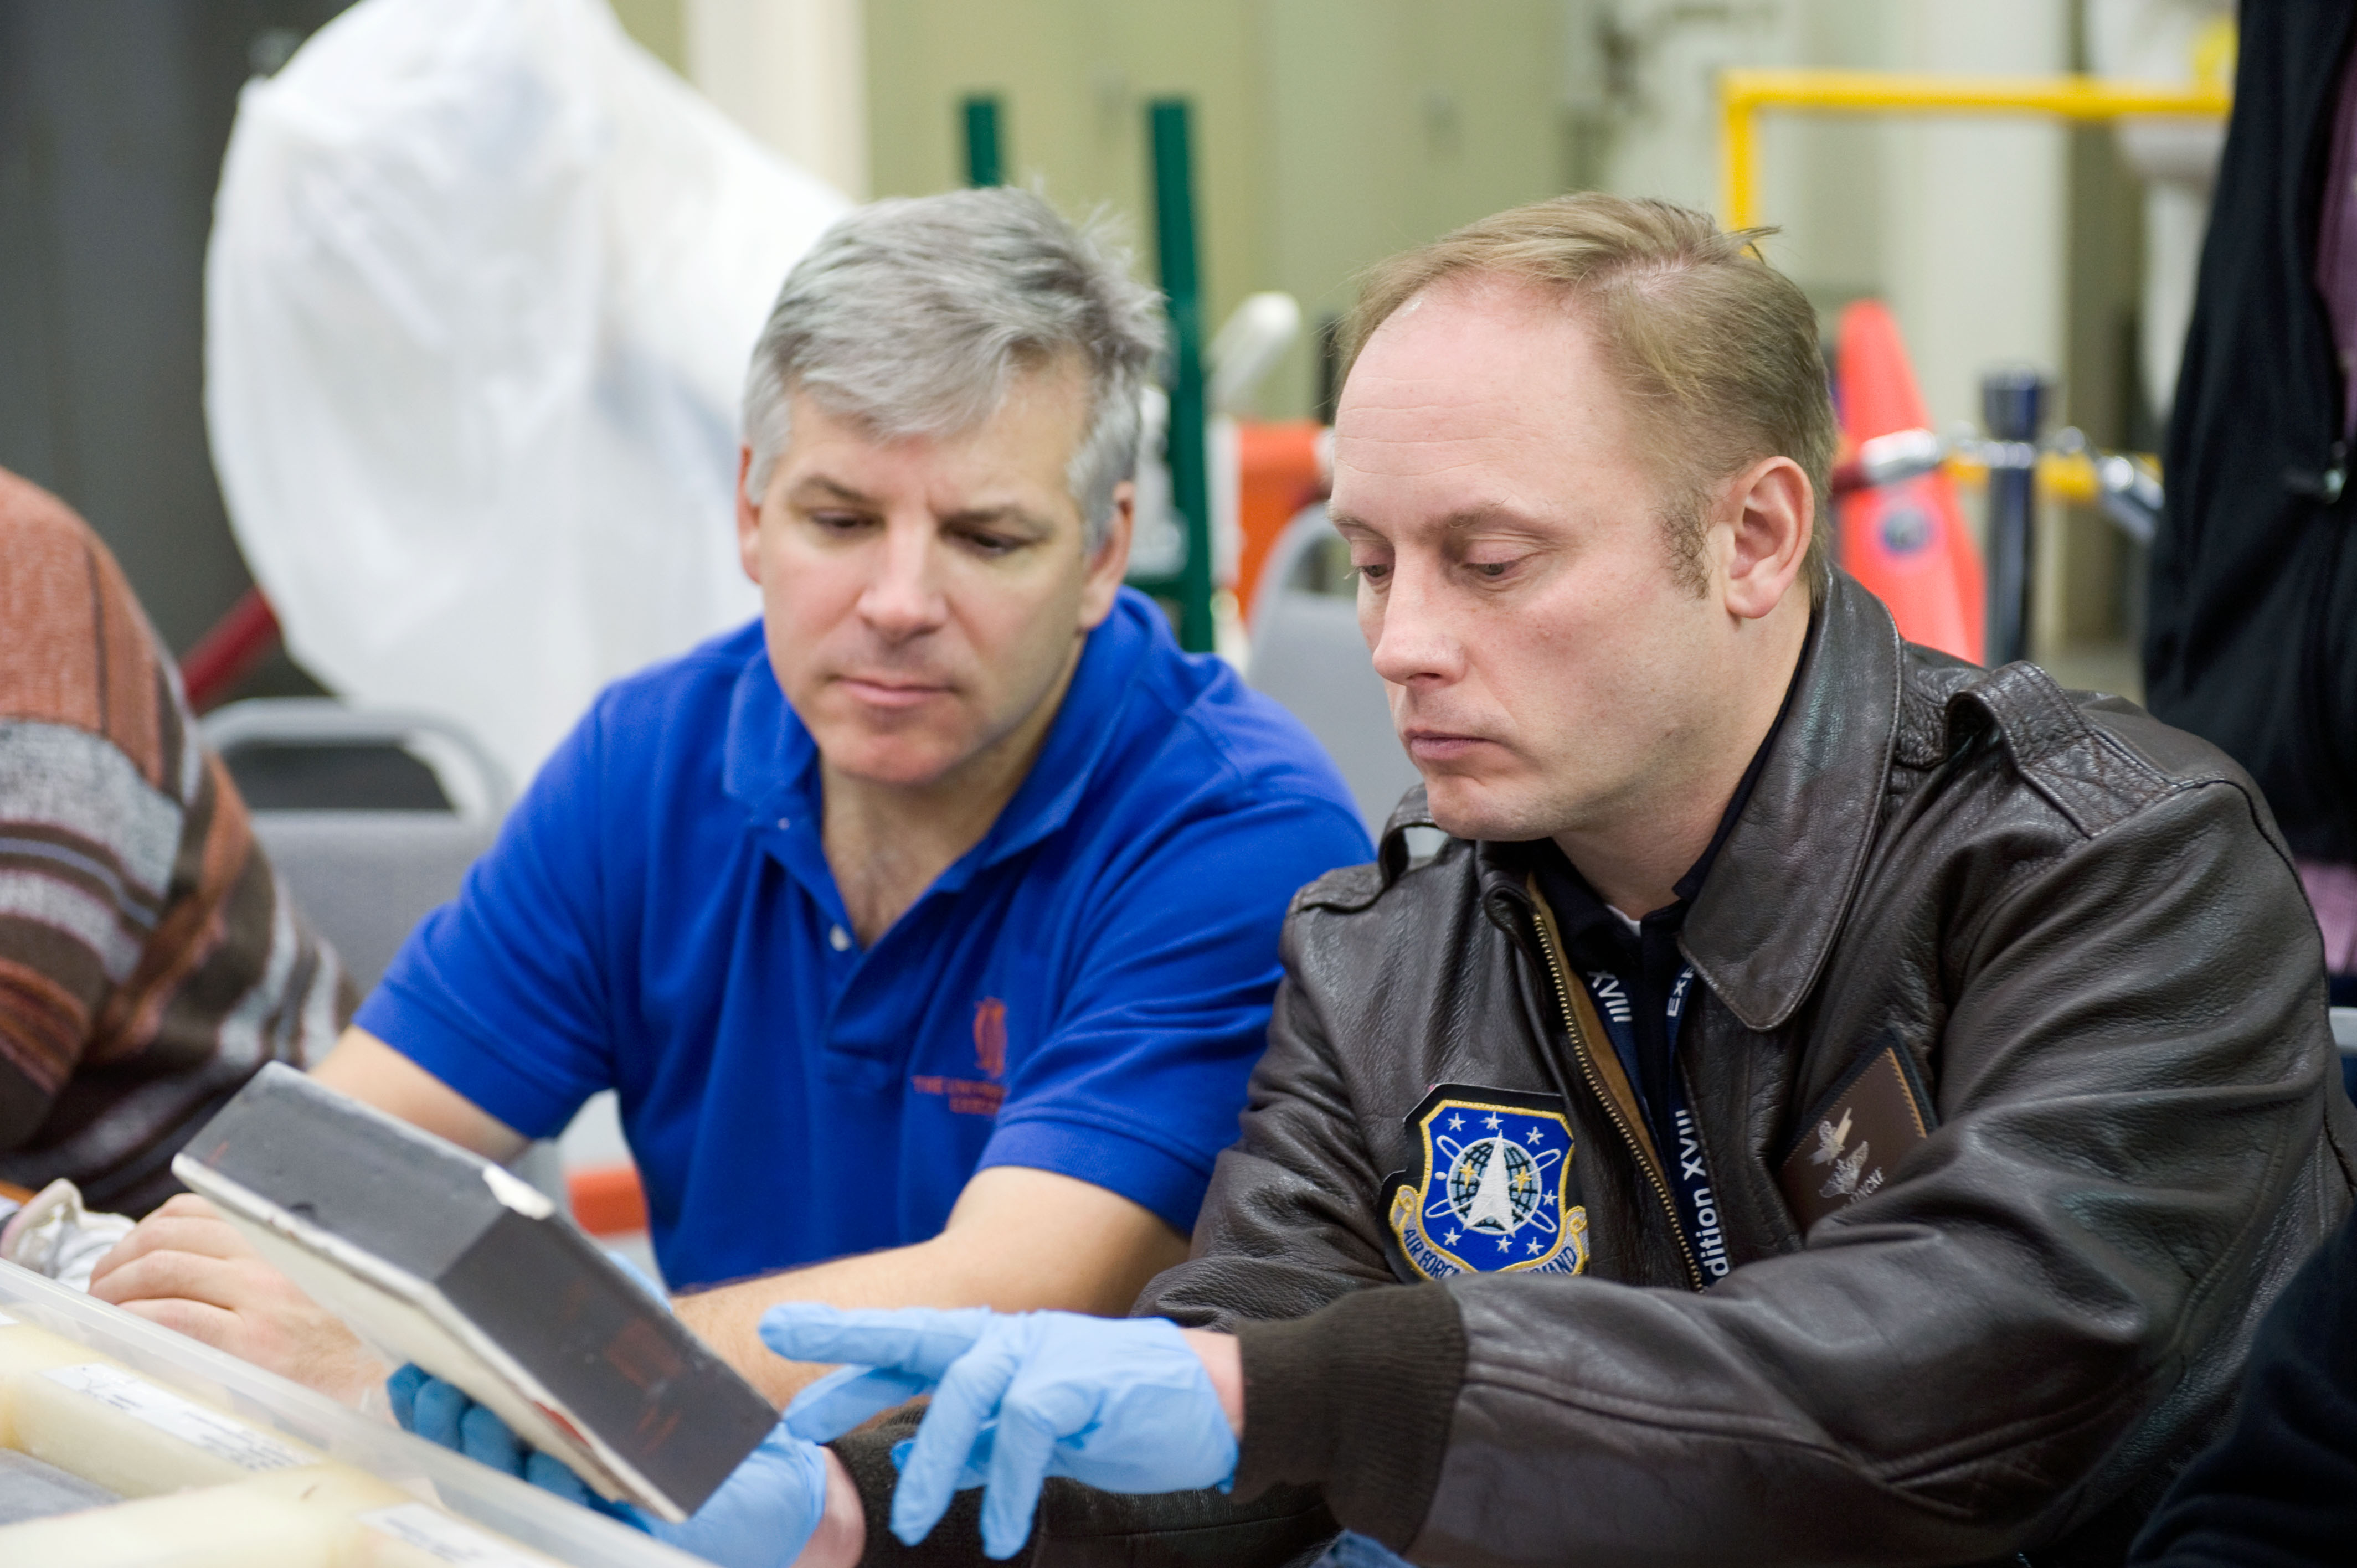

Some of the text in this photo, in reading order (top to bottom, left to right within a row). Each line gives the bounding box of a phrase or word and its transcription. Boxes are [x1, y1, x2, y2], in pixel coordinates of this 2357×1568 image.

[1675, 1109, 1707, 1181] XVIII
[1404, 1229, 1424, 1257] AIR
[1417, 1250, 1460, 1280] FORC
